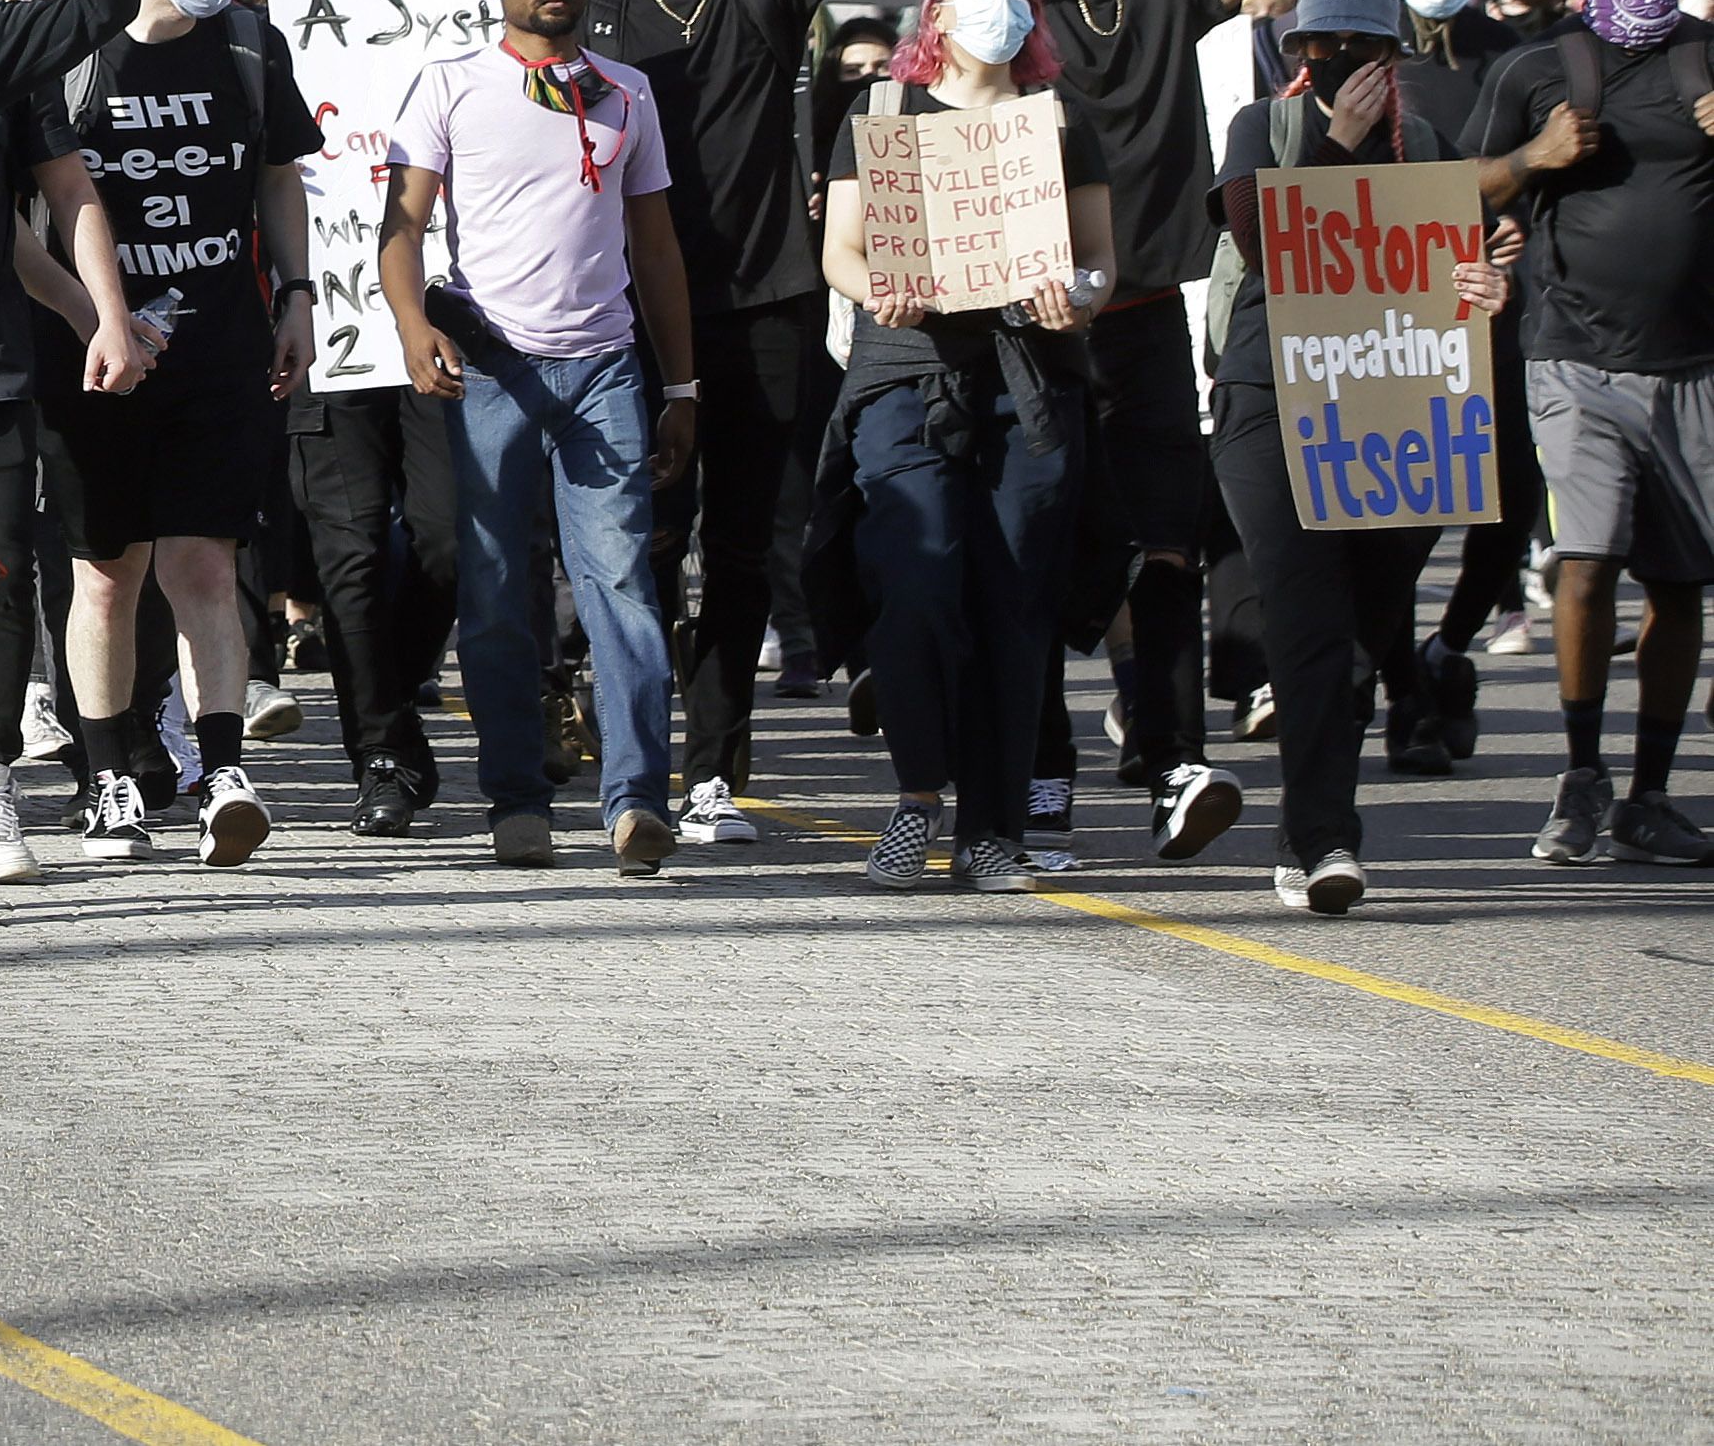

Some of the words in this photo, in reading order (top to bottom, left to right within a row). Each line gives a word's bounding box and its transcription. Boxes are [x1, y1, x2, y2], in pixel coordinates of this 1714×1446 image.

[315, 101, 390, 161] Can
[868, 126, 938, 160] USE
[954, 114, 1034, 154] YOUR
[864, 202, 918, 224] AND
[953, 181, 1062, 222] FUCKING
[868, 156, 1035, 195] PRIVILEGE
[869, 271, 950, 300] BLACK
[965, 241, 1071, 294] LIVES!!
[872, 230, 1003, 258] PROTECT
[1262, 178, 1484, 321] History
[325, 324, 376, 379] 2
[1281, 309, 1470, 401] repeating
[1297, 395, 1492, 522] itself
